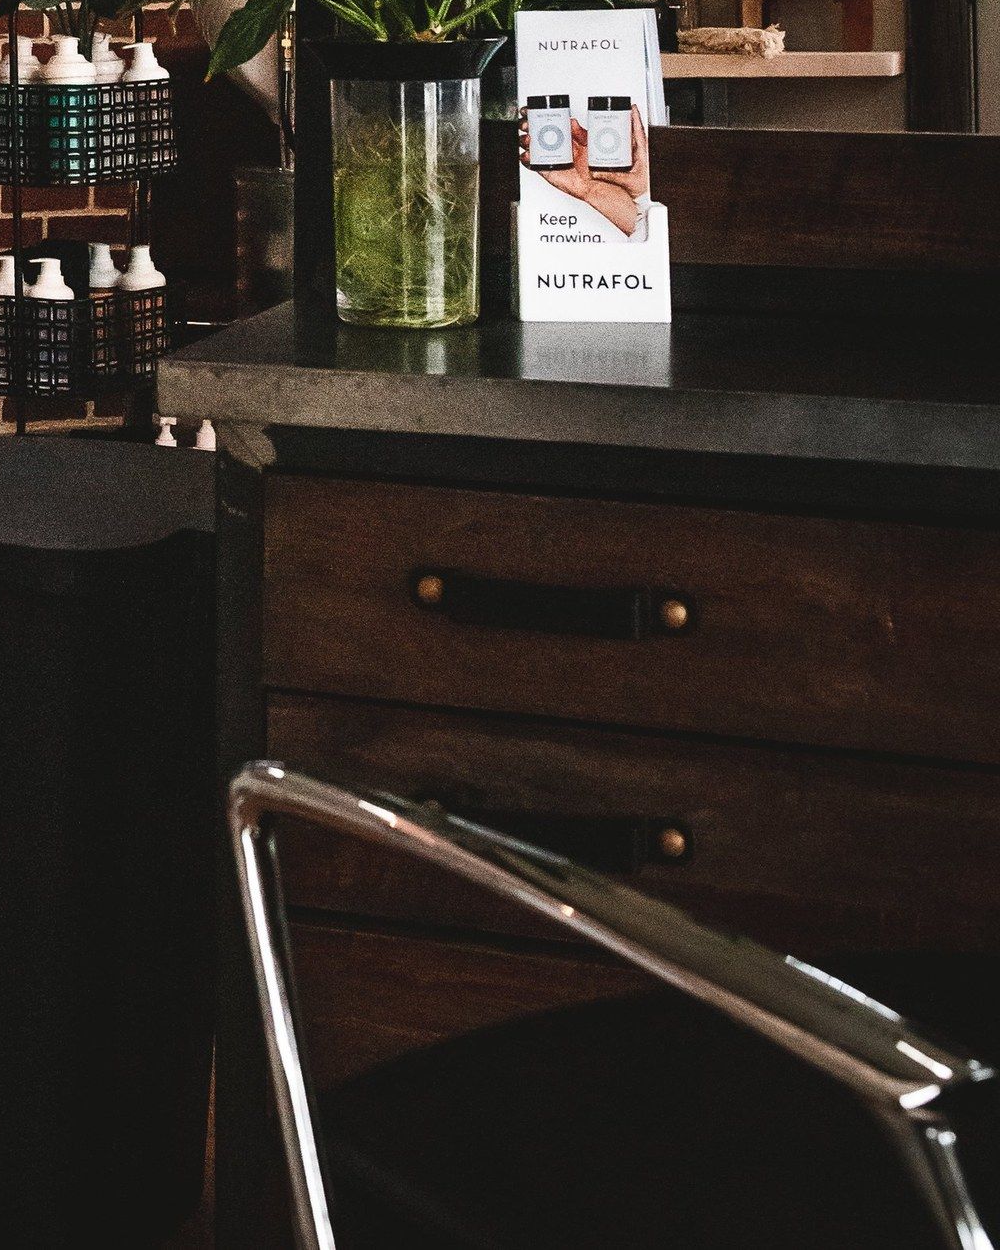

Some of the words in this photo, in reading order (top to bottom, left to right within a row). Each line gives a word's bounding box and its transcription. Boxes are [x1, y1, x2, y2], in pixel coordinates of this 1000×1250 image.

[538, 39, 620, 51] NUTRAFOL
[539, 213, 578, 229] Keep
[537, 274, 653, 290] NUTRAFOL
